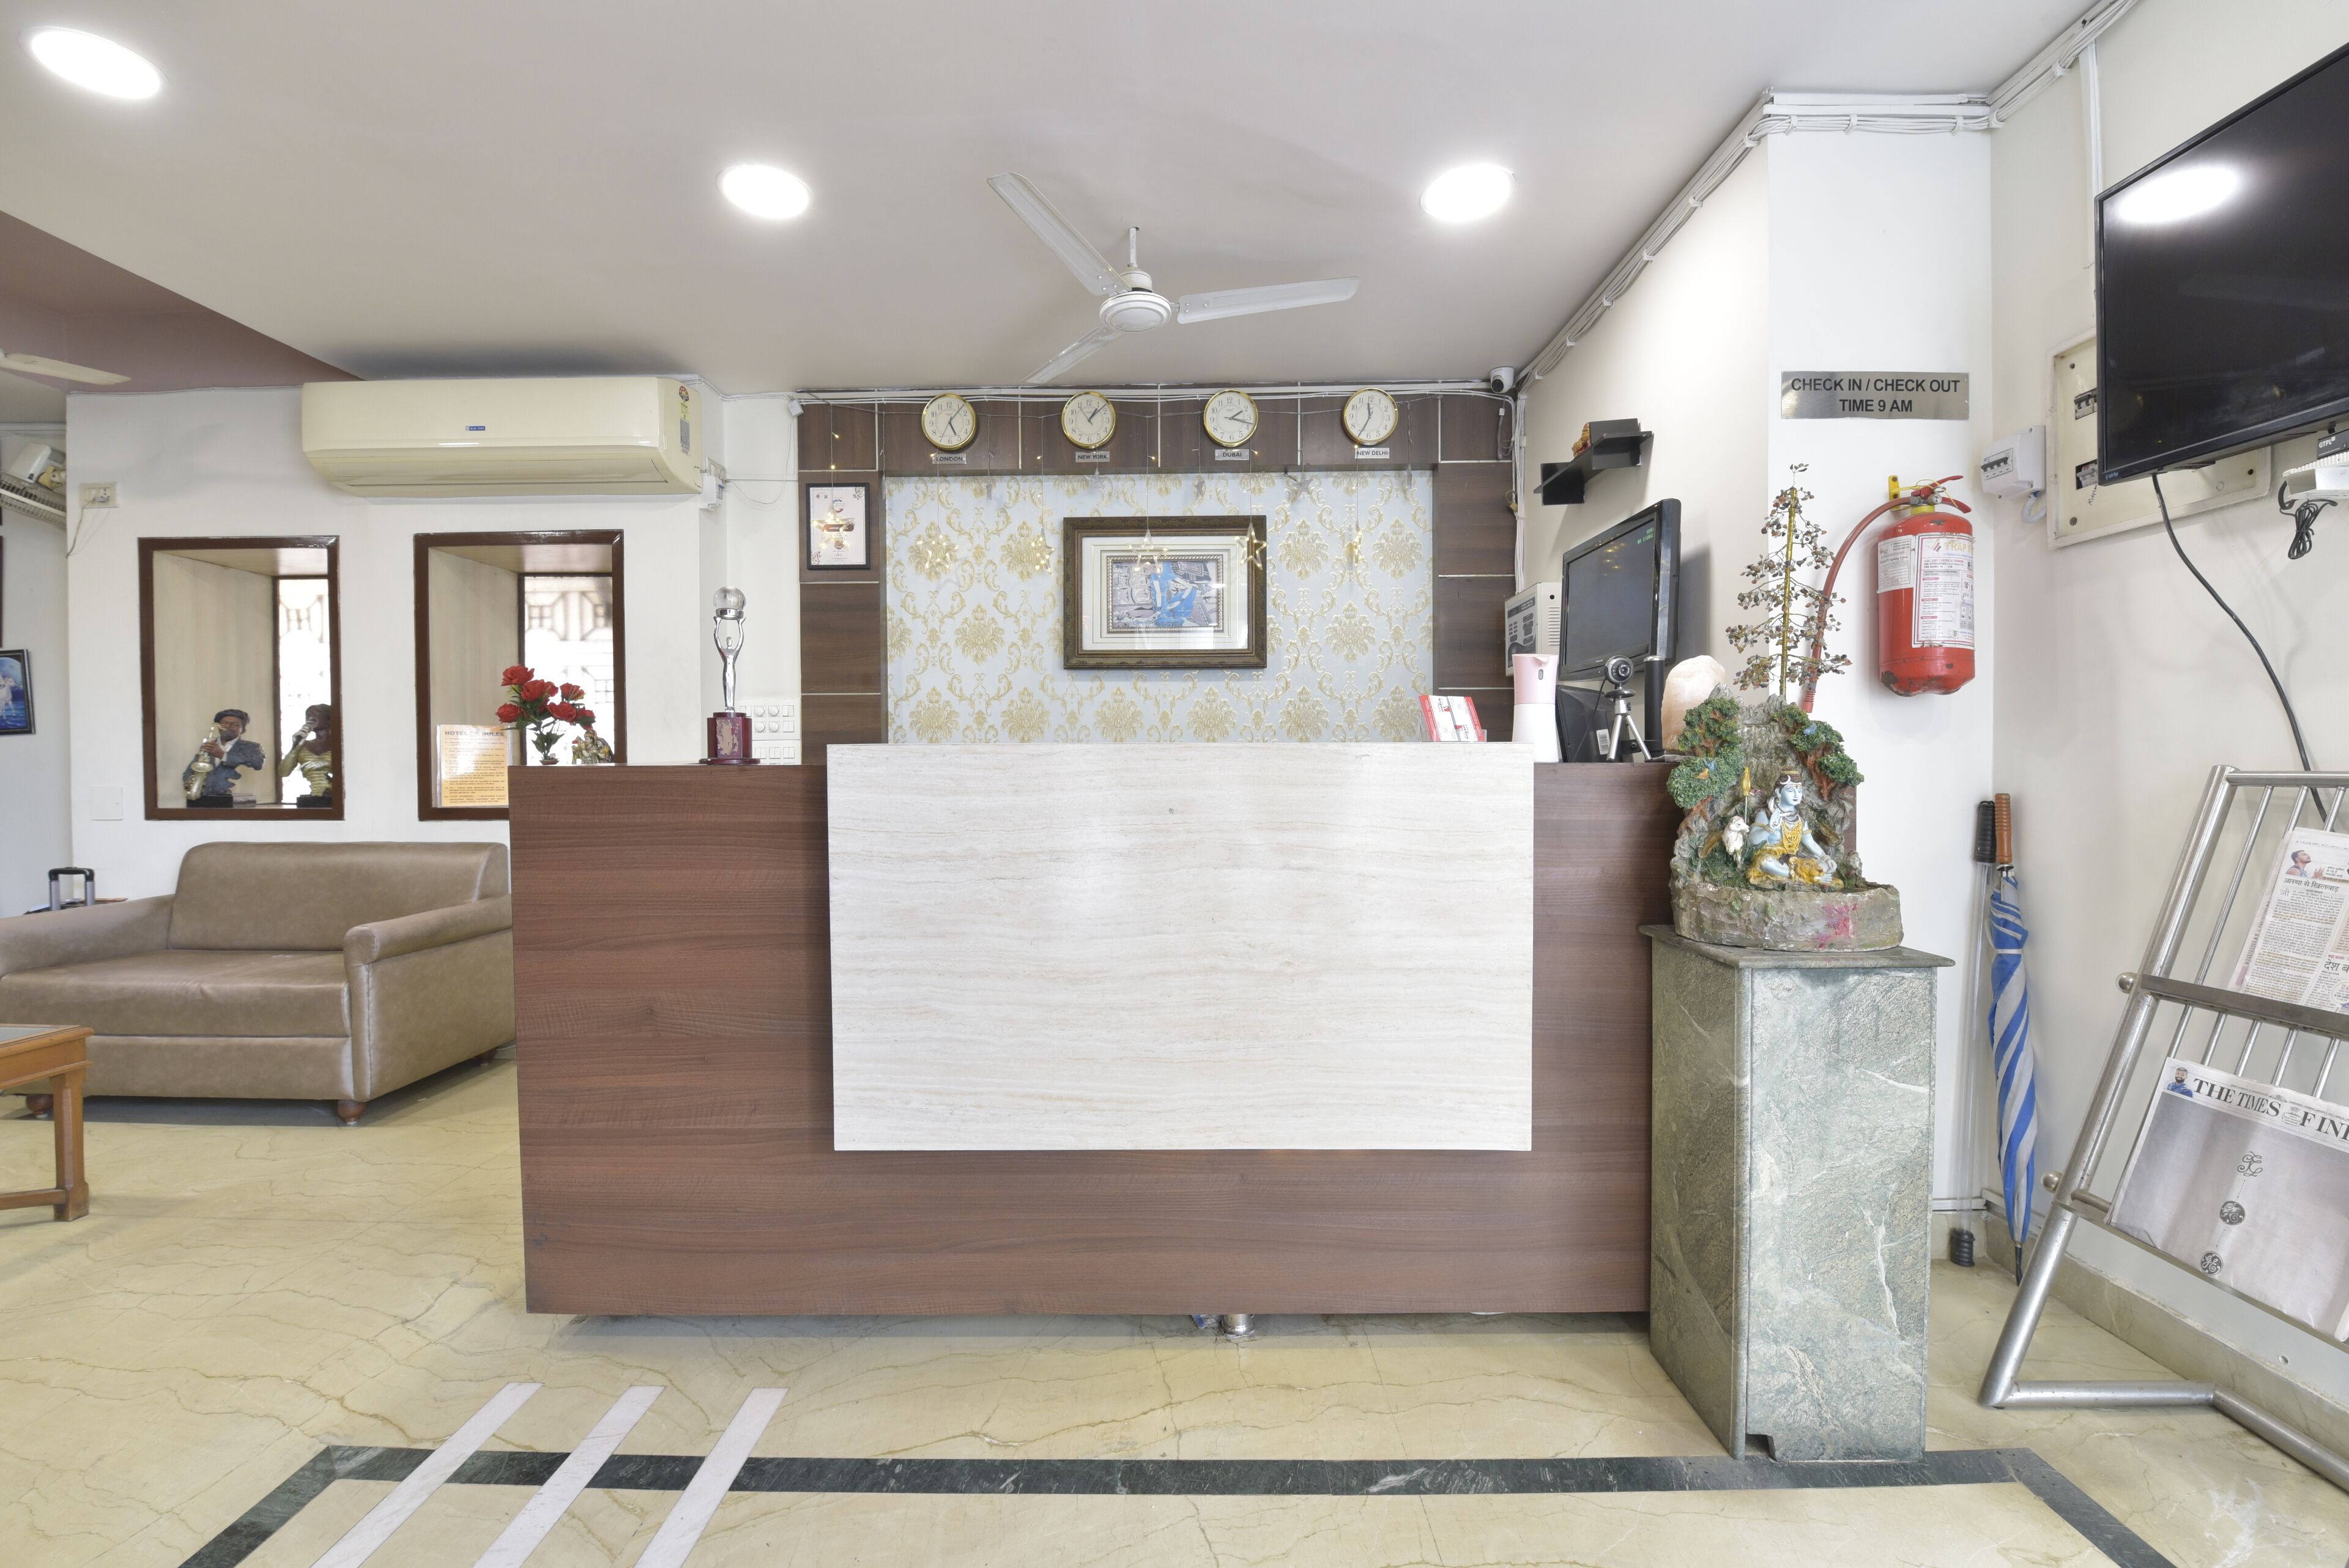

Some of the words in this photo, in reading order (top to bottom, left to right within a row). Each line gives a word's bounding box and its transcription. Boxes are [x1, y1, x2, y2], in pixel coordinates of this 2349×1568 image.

[1791, 378, 1843, 392] CHECK
[1848, 379, 1862, 391] IN
[1874, 379, 1925, 392] CHECK
[1929, 380, 1960, 392] OUT
[1839, 399, 1874, 412] TIME
[1878, 399, 1886, 412] 9
[1890, 399, 1913, 412] AM
[2319, 439, 2332, 448] GTPL
[2325, 959, 2340, 971] देश
[2193, 1078, 2235, 1103] THE
[2236, 1092, 2281, 1117] TIMES
